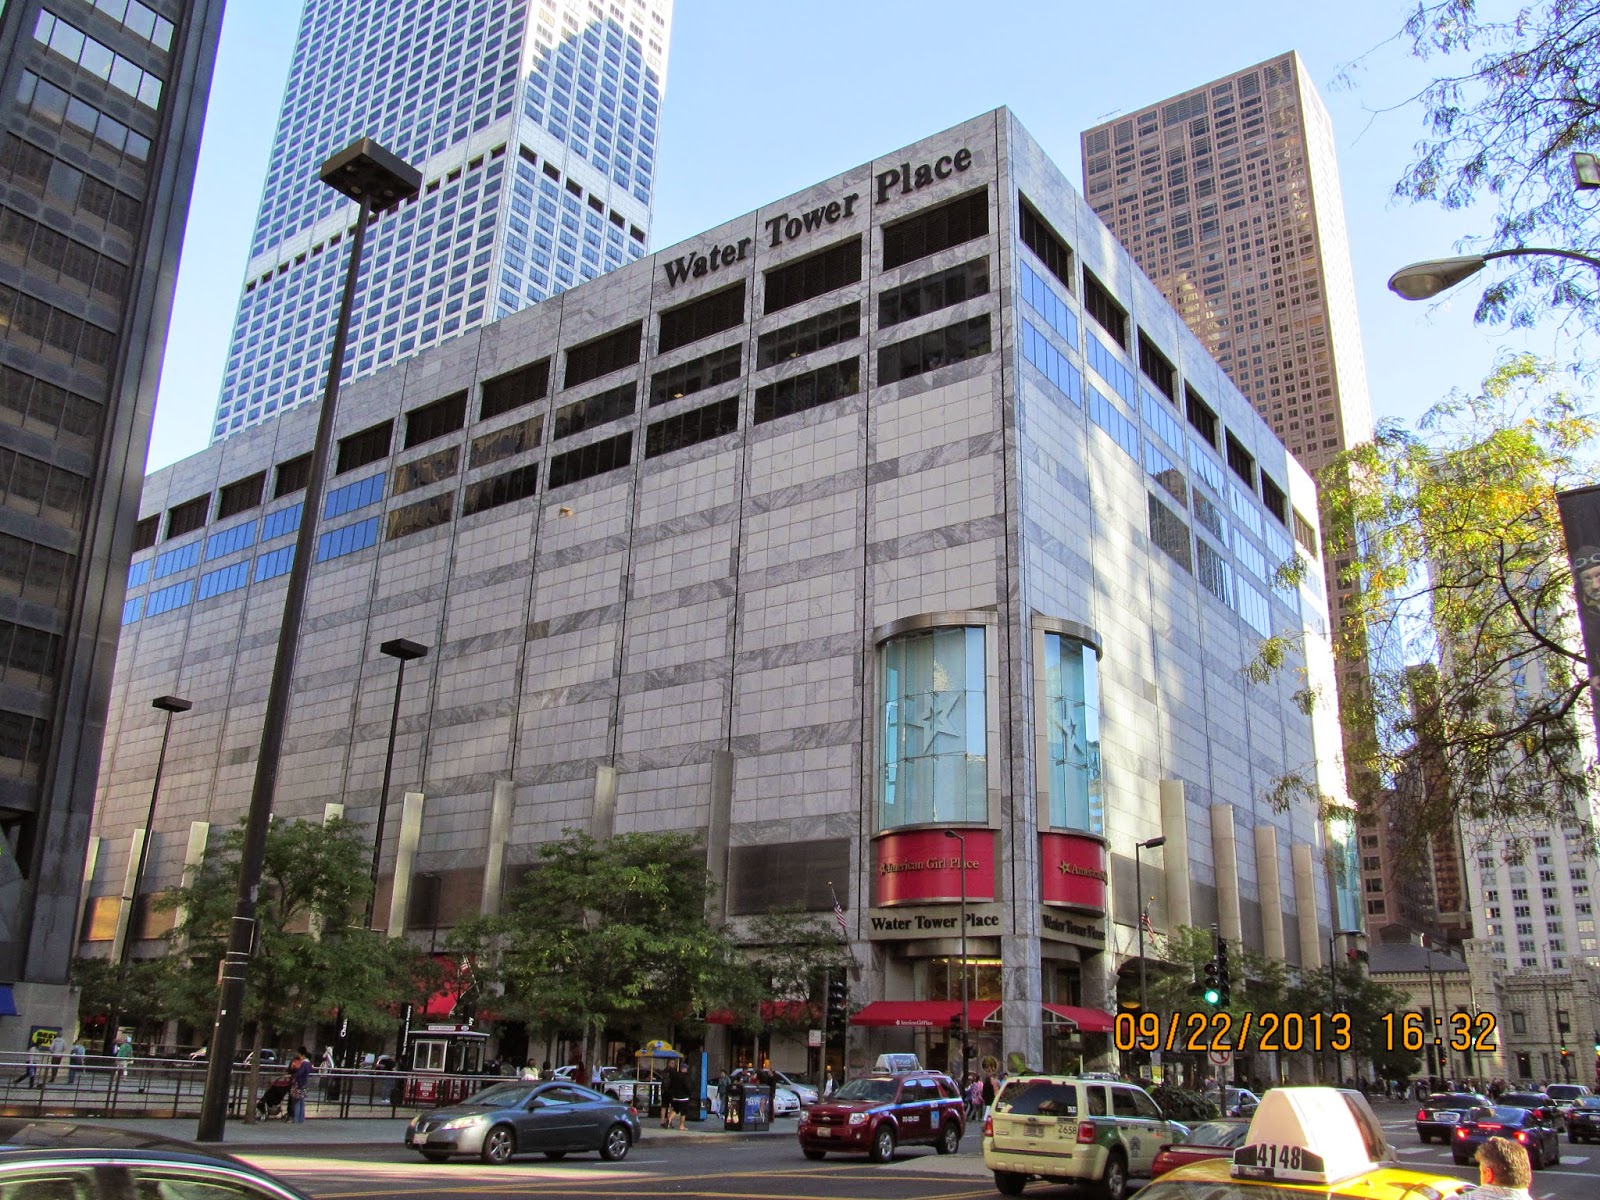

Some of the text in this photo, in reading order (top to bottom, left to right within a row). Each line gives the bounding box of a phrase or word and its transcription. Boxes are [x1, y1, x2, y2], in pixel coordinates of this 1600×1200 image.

[663, 147, 973, 288] Water Tower Place
[884, 859, 924, 874] American
[926, 857, 946, 870] Girl
[871, 917, 912, 931] Water
[914, 915, 958, 930] Tower
[1042, 914, 1065, 933] Water
[1065, 919, 1087, 937] Tower
[1058, 1124, 1077, 1135] 2658
[1257, 1143, 1301, 1170] 4148
